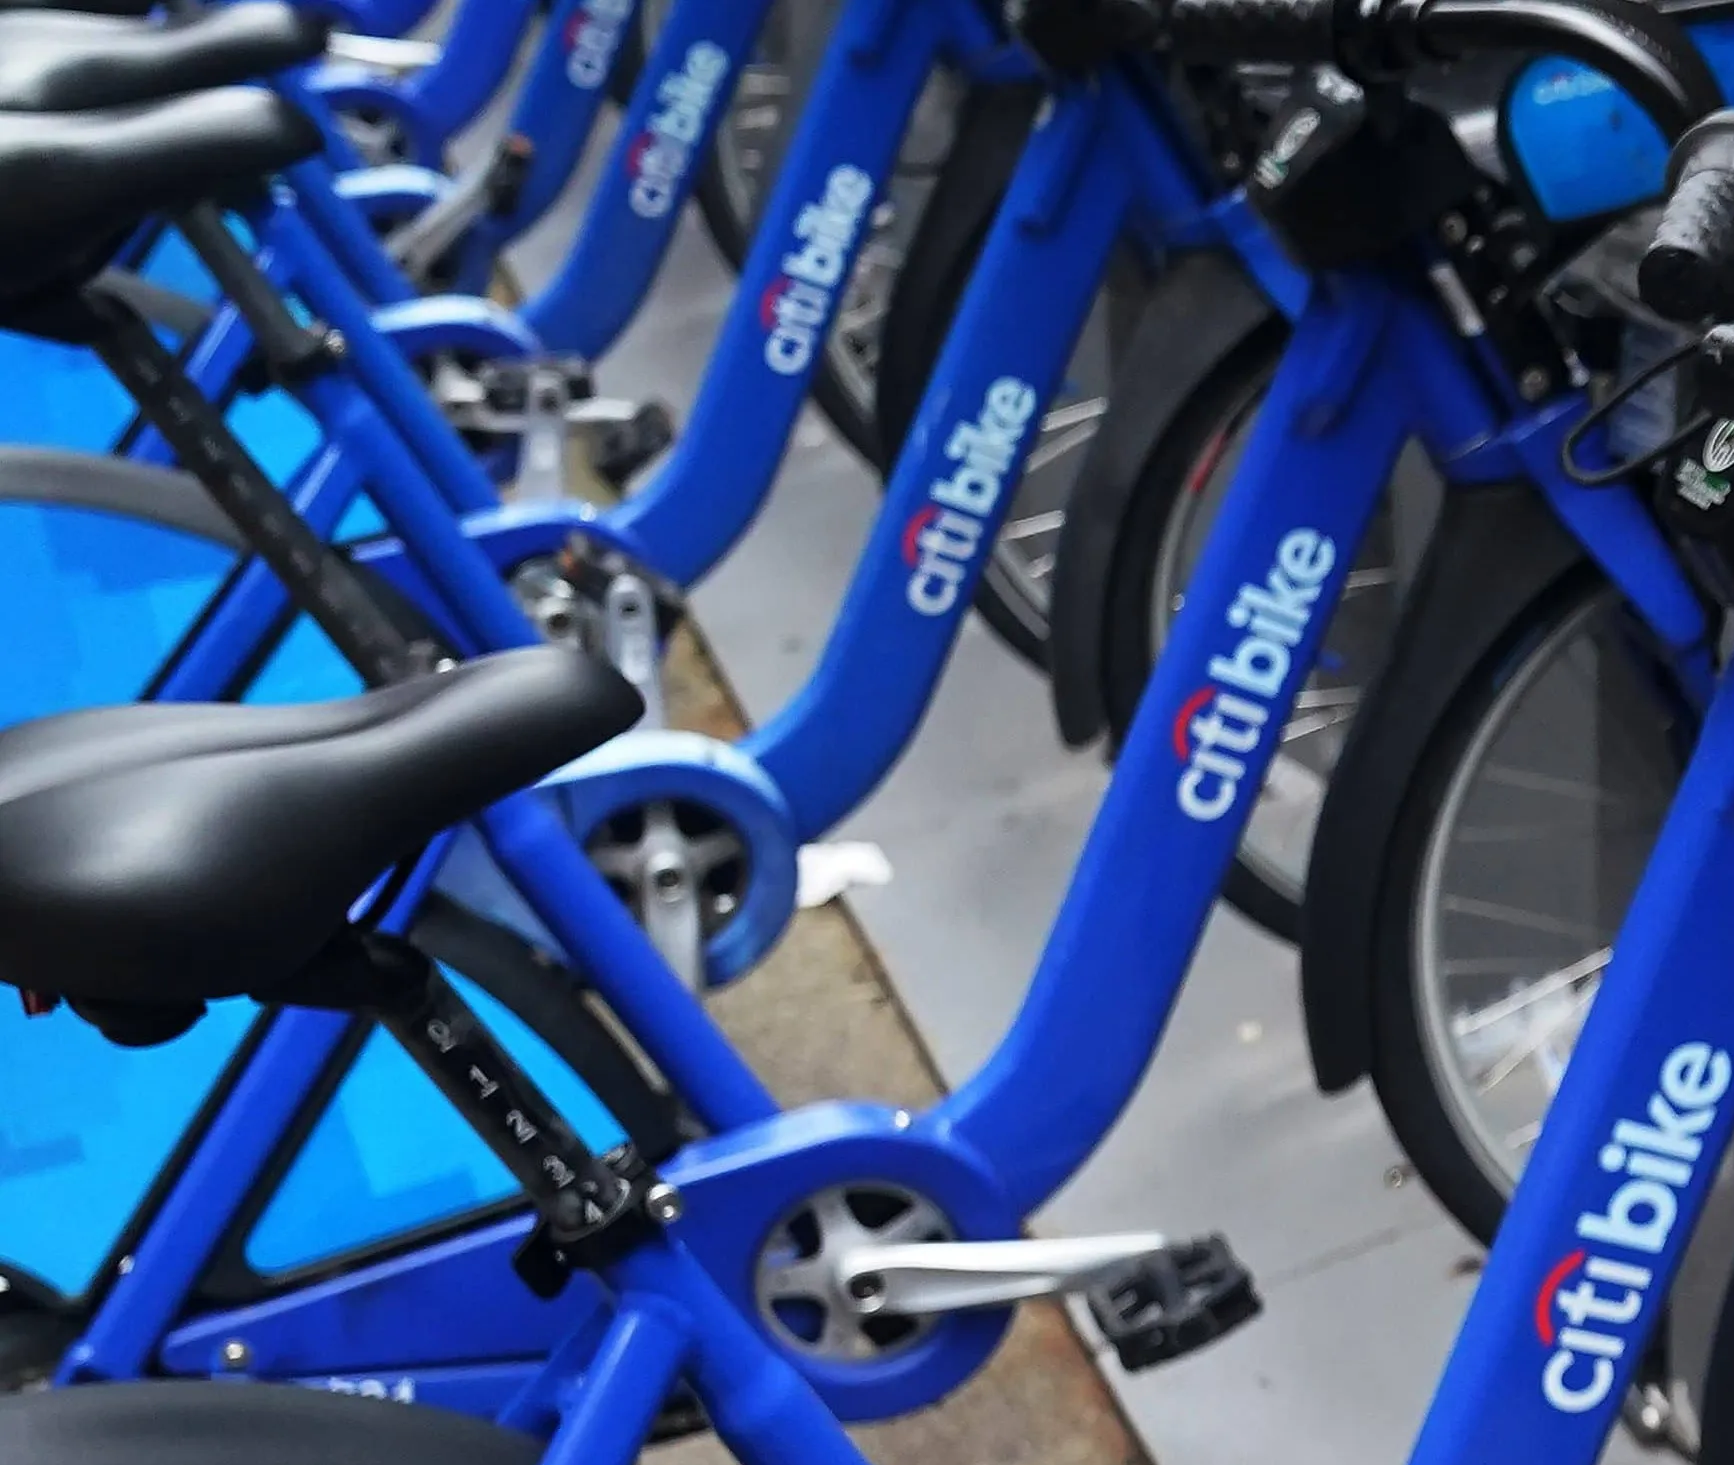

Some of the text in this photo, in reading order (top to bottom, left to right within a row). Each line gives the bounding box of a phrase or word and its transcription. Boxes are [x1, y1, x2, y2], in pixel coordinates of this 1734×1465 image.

[782, 163, 875, 287] bike
[903, 376, 1036, 616] citi bike
[1173, 527, 1336, 823] citi bike
[468, 1063, 499, 1099] 1
[506, 1107, 538, 1144] 2
[1535, 1041, 1733, 1414] citi bike
